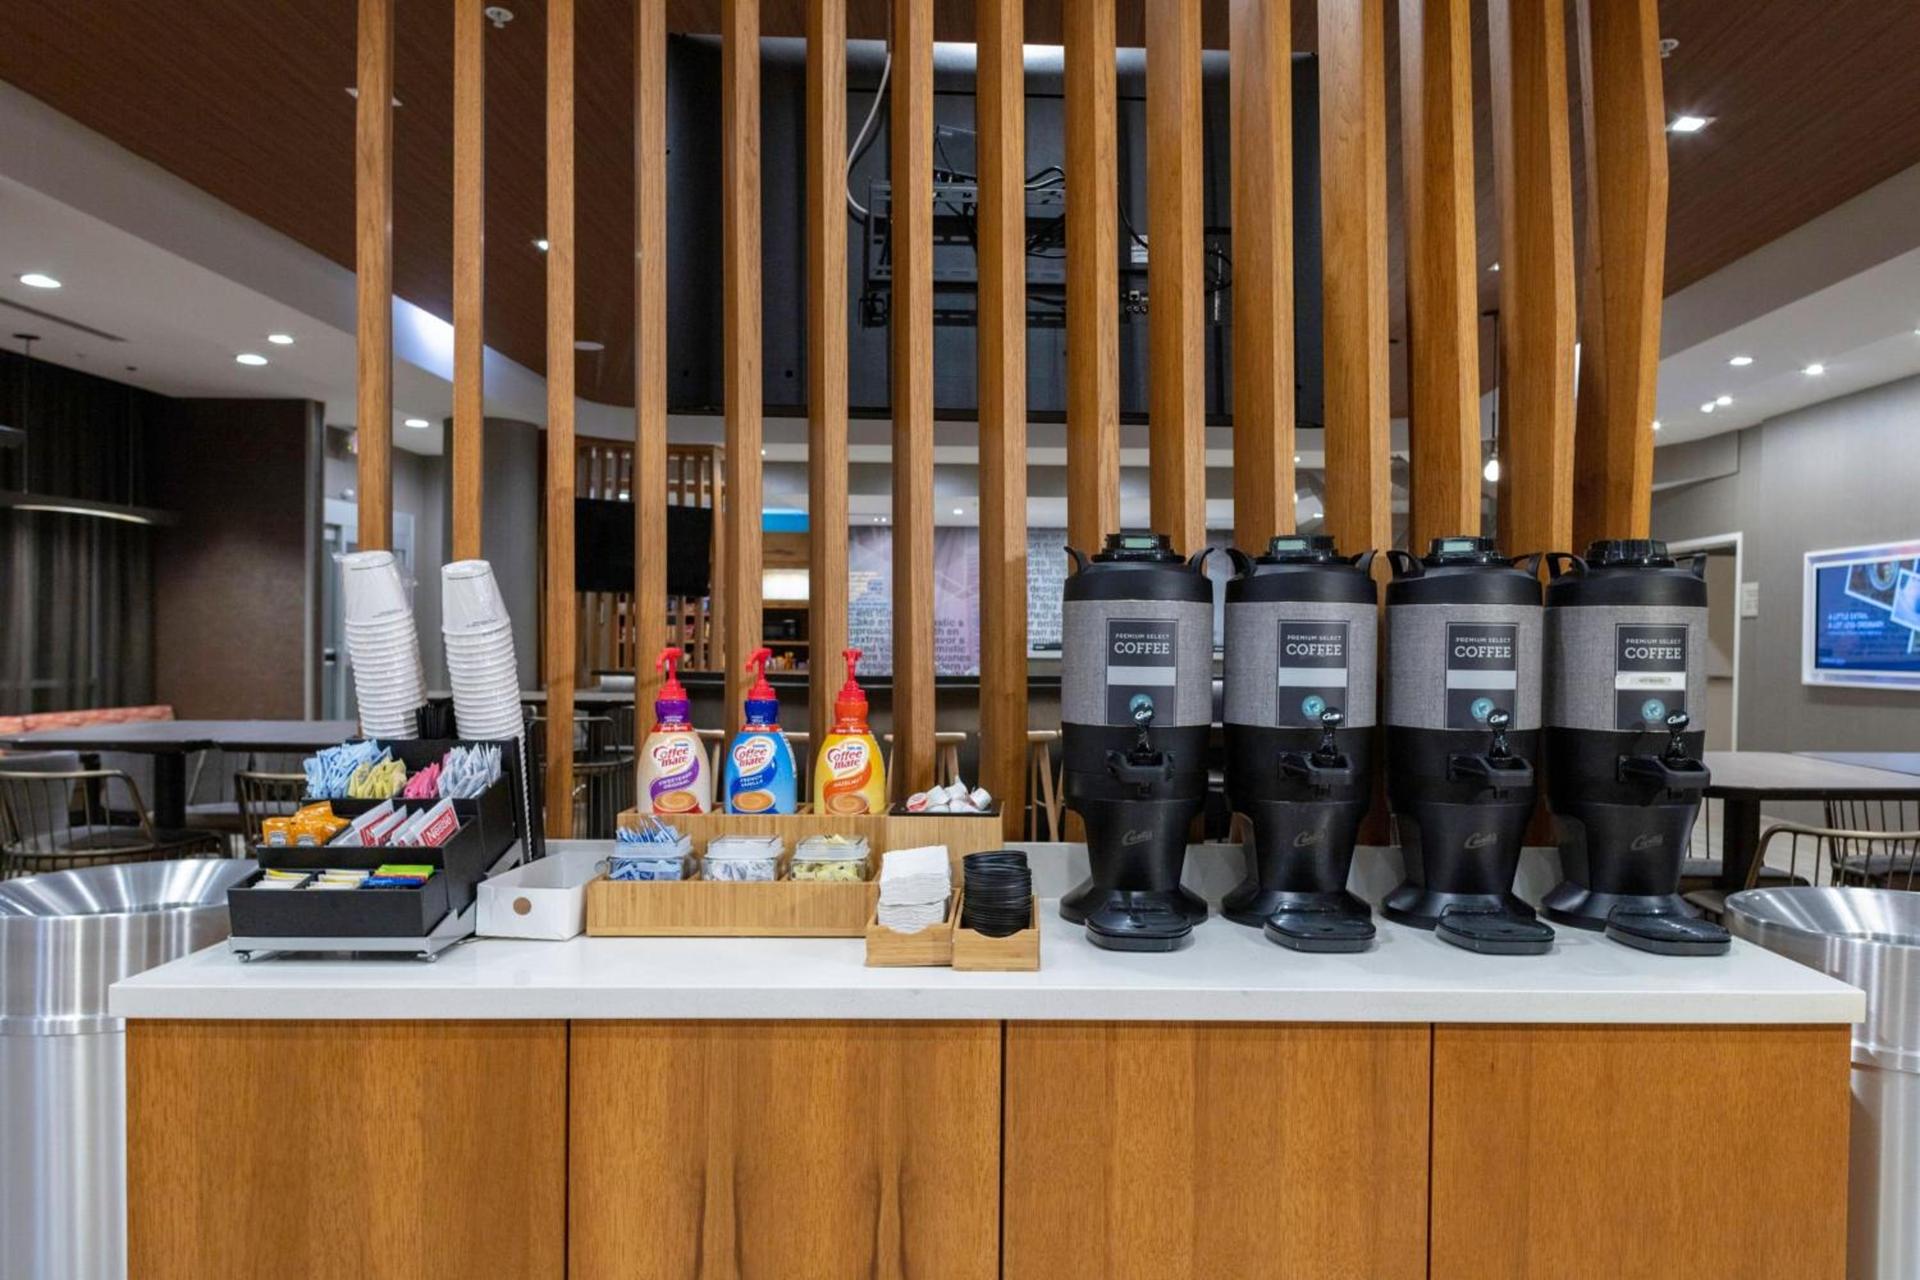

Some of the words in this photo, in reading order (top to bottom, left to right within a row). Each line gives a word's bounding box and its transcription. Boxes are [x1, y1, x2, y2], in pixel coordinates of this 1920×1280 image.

[1114, 641, 1170, 654] COFFEE
[1286, 643, 1342, 656] COFFEE
[1454, 645, 1511, 658] COFFEE
[1624, 647, 1682, 660] COFFEE
[653, 745, 689, 761] Coffee
[735, 745, 767, 761] Coffee
[827, 748, 862, 763] Coffee
[661, 756, 688, 768] mate
[740, 756, 765, 767] mate
[834, 759, 860, 770] mate
